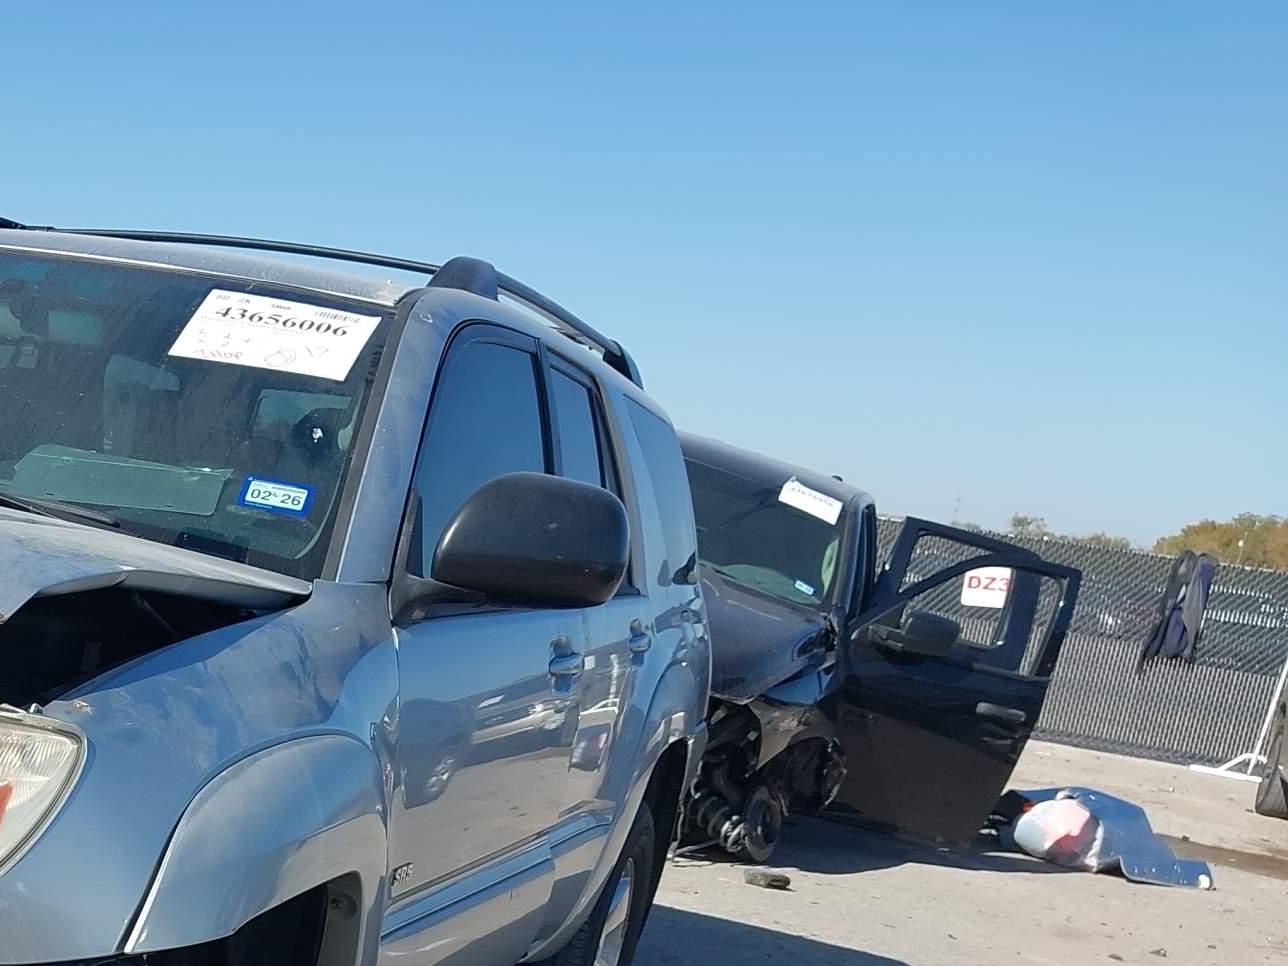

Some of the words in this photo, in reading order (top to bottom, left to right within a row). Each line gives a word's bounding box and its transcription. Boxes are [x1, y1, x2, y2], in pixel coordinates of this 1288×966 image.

[215, 306, 350, 337] 43656006
[250, 488, 272, 502] 02
[279, 493, 302, 507] 26
[967, 575, 1012, 592] DZ3
